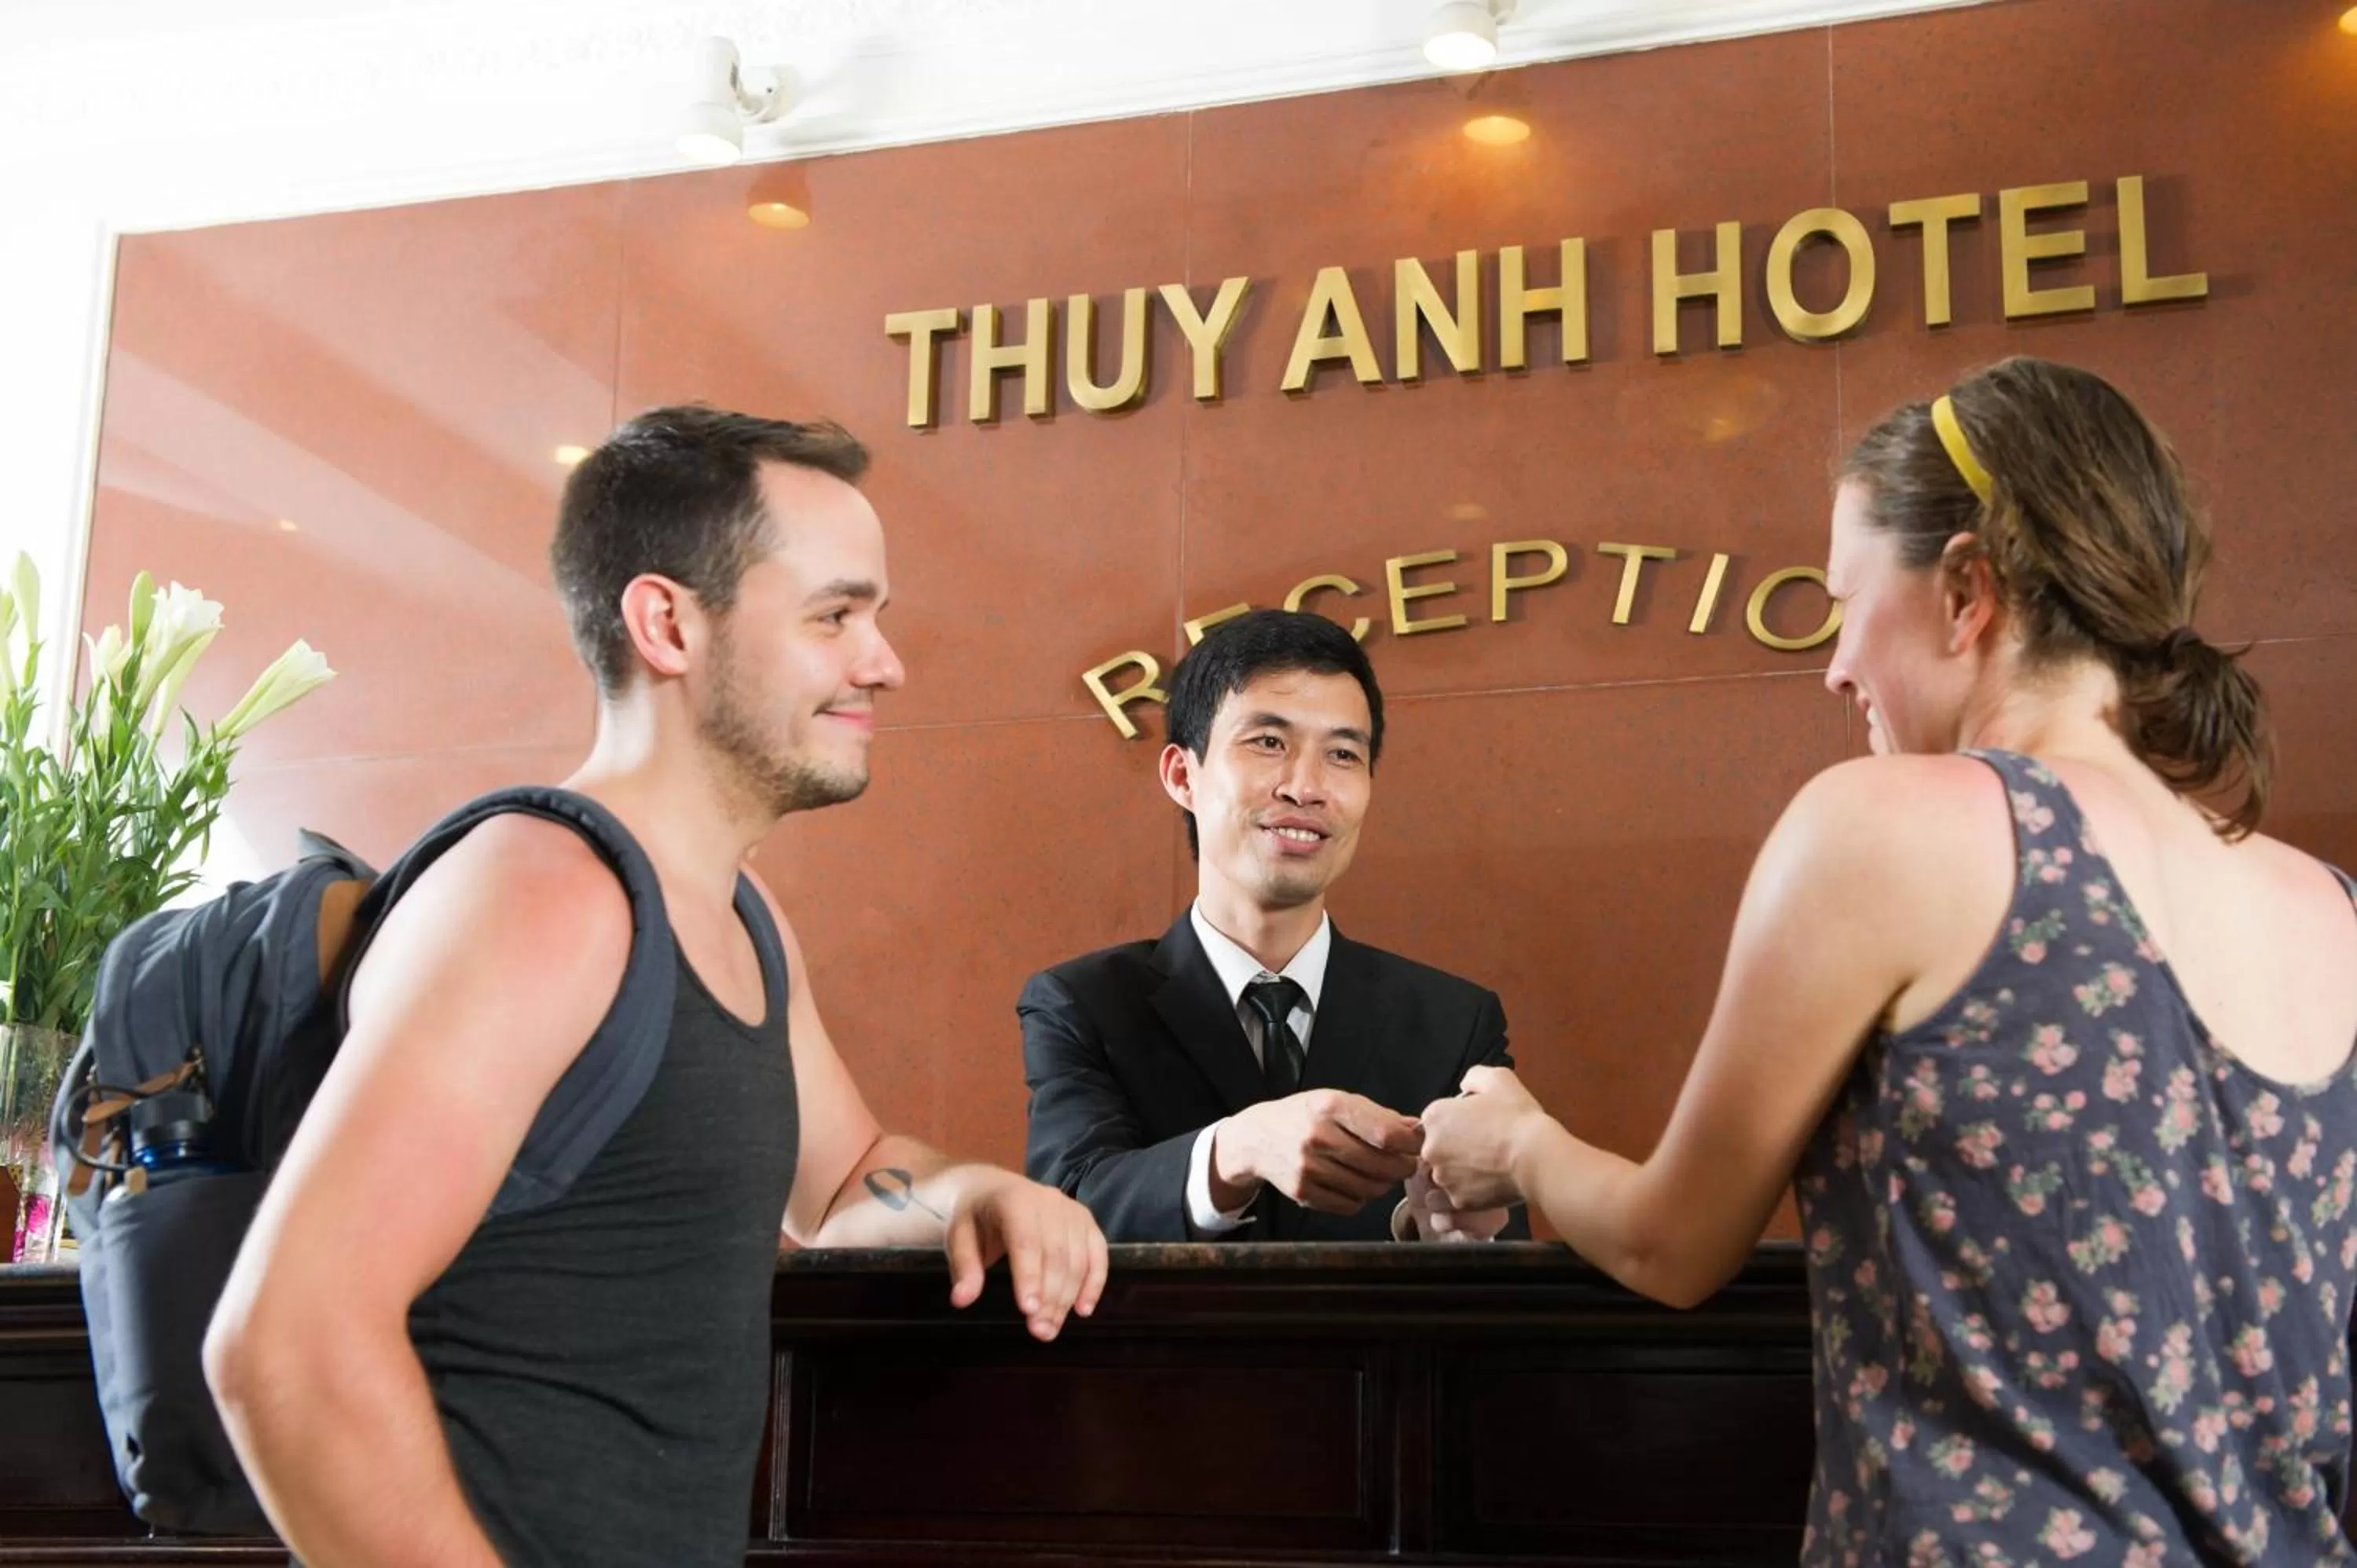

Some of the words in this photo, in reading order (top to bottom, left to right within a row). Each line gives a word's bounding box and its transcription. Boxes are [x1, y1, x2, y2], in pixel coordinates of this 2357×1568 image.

[885, 276, 1249, 428] THUY
[1281, 236, 1589, 393] ANH
[1651, 175, 2209, 356] HOTEL
[1081, 539, 1843, 739] RCEPTIO
